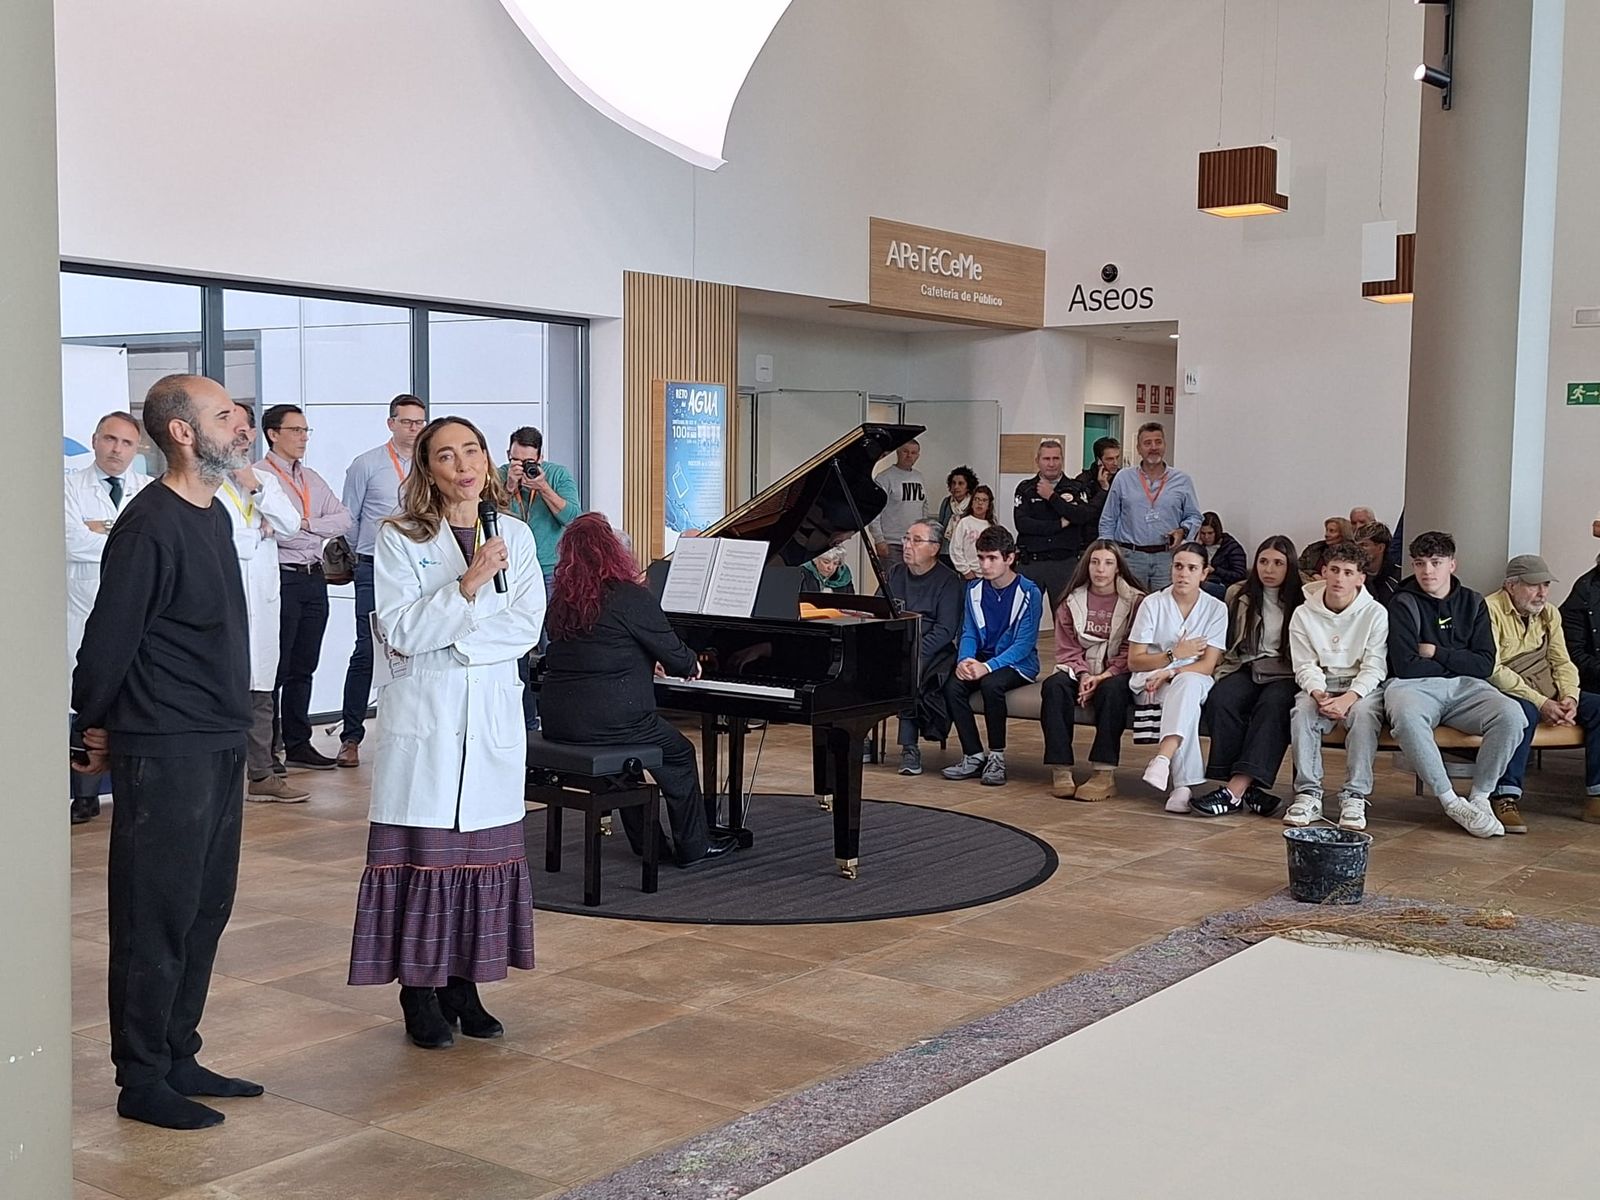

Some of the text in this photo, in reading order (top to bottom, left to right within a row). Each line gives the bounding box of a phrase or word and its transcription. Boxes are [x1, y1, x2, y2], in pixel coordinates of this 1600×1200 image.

[961, 291, 971, 302] de
[974, 291, 1003, 306] Público
[1068, 284, 1154, 312] Aseos
[687, 388, 718, 416] AGUA
[672, 425, 686, 438] 100
[902, 482, 925, 501] NYC
